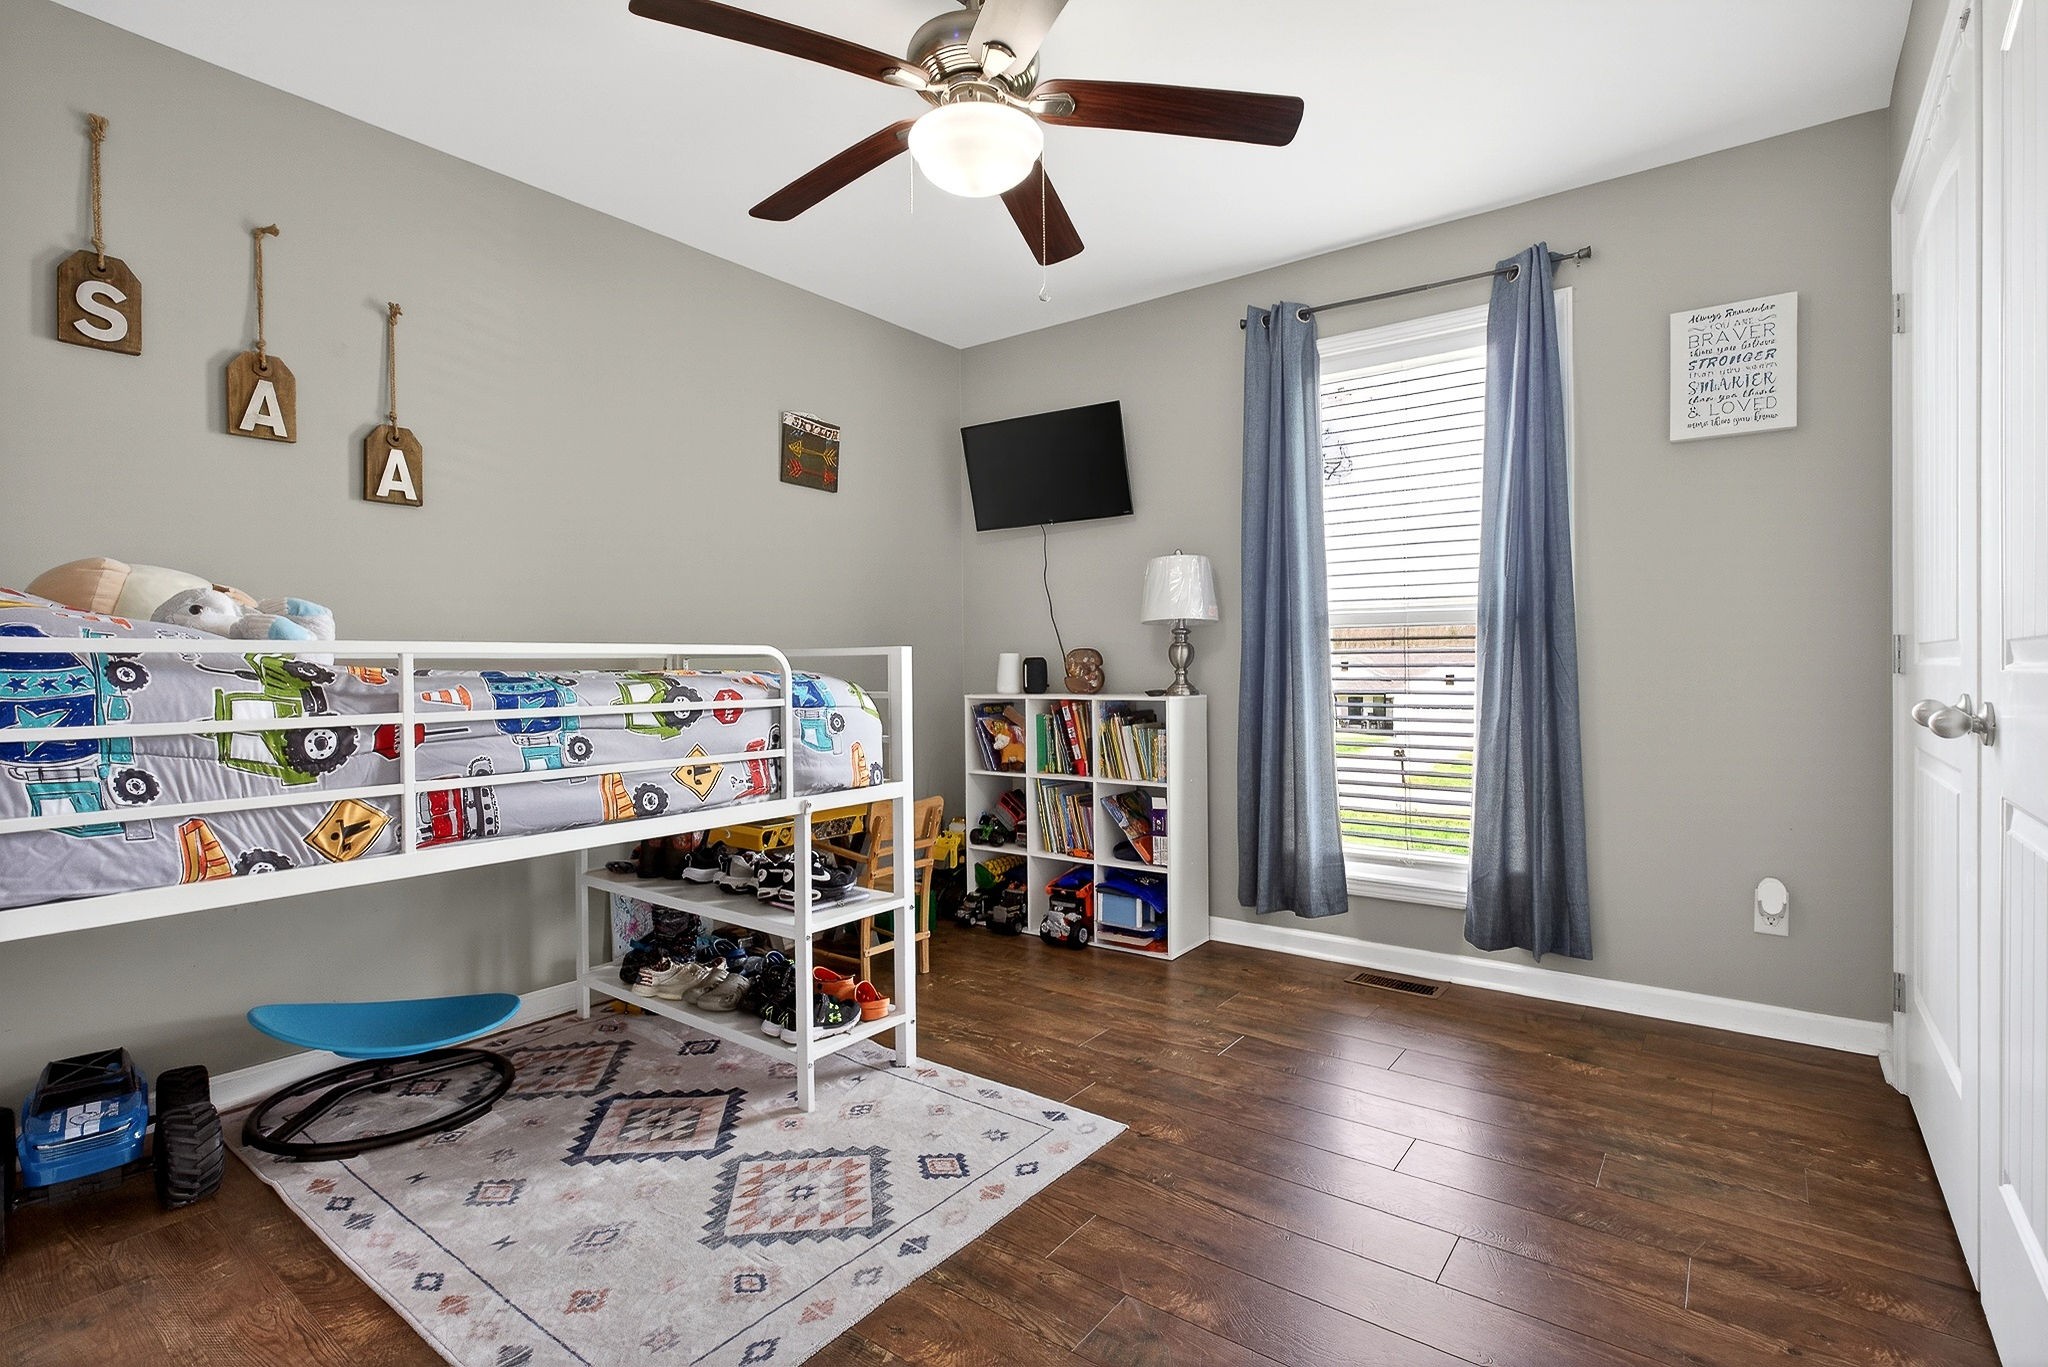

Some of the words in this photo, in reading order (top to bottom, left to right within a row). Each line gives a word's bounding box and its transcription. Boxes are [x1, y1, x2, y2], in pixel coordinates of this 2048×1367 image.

[73, 280, 129, 342] S
[1688, 322, 1776, 350] BRAVER
[1688, 348, 1777, 371] STRONGER
[239, 379, 288, 438] A
[1709, 396, 1778, 416] LOVED
[375, 448, 418, 500] A
